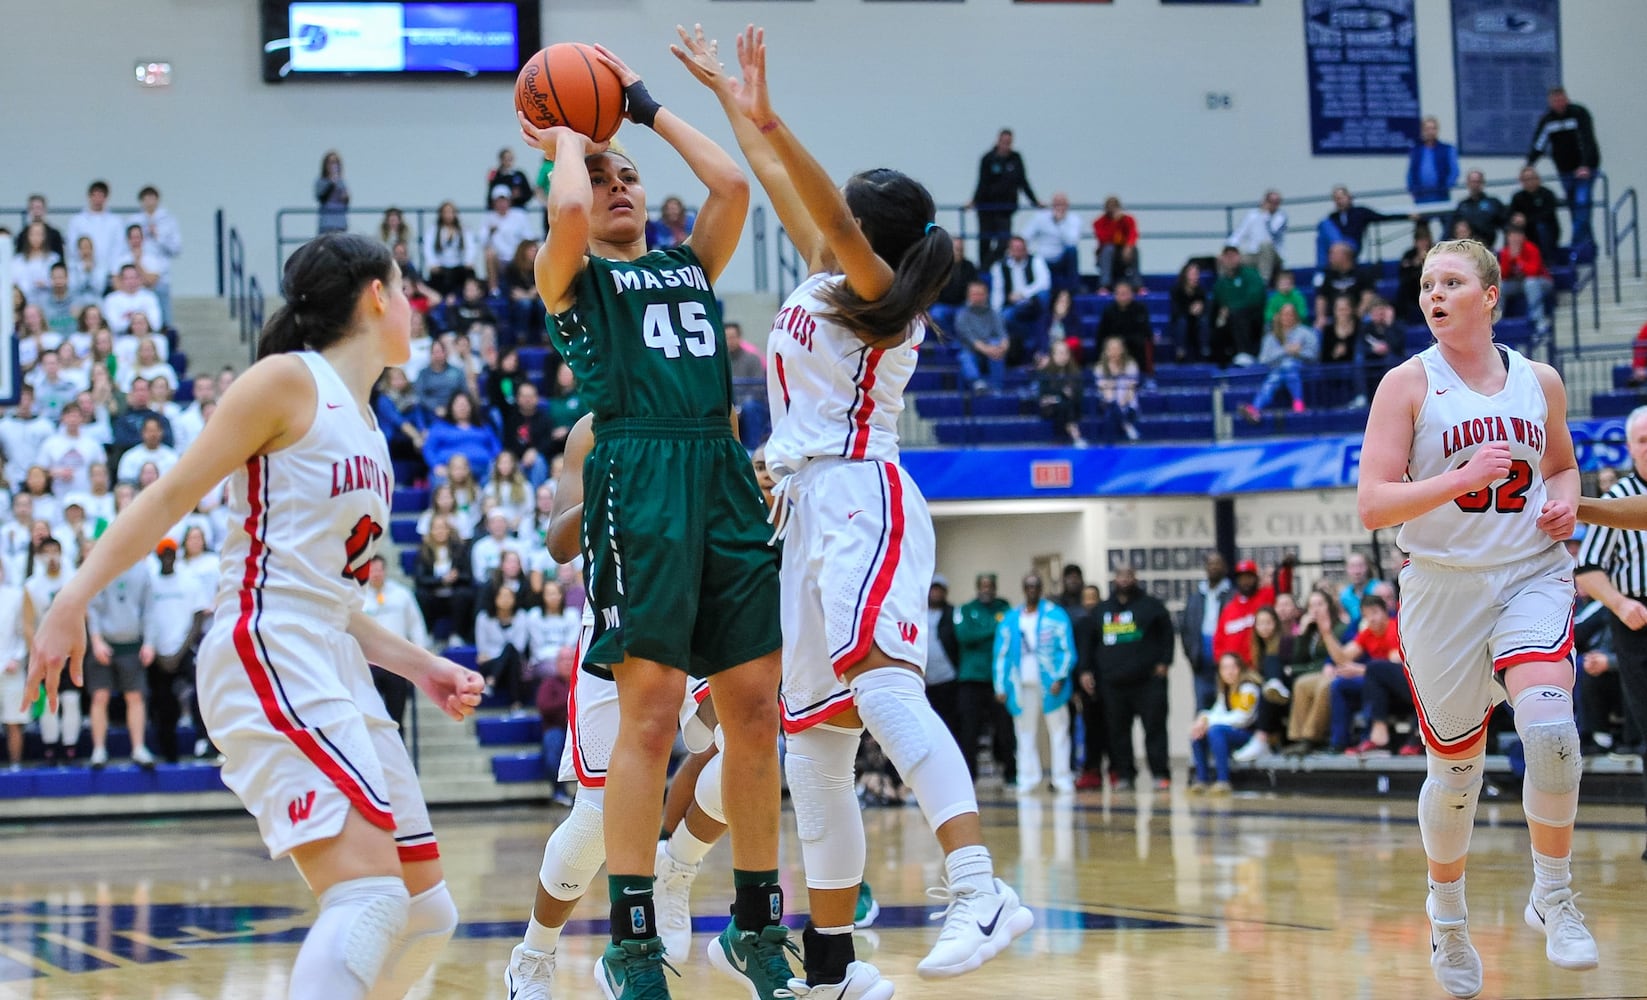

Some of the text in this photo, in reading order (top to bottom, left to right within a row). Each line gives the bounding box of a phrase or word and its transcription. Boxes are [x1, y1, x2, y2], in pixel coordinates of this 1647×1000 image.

[525, 64, 559, 126] Rawlings
[610, 264, 709, 294] MASON
[642, 301, 716, 359] 45
[1442, 416, 1509, 459] LAKOTA
[329, 455, 382, 499] LAKOTA
[1153, 511, 1362, 539] STAE CHAM
